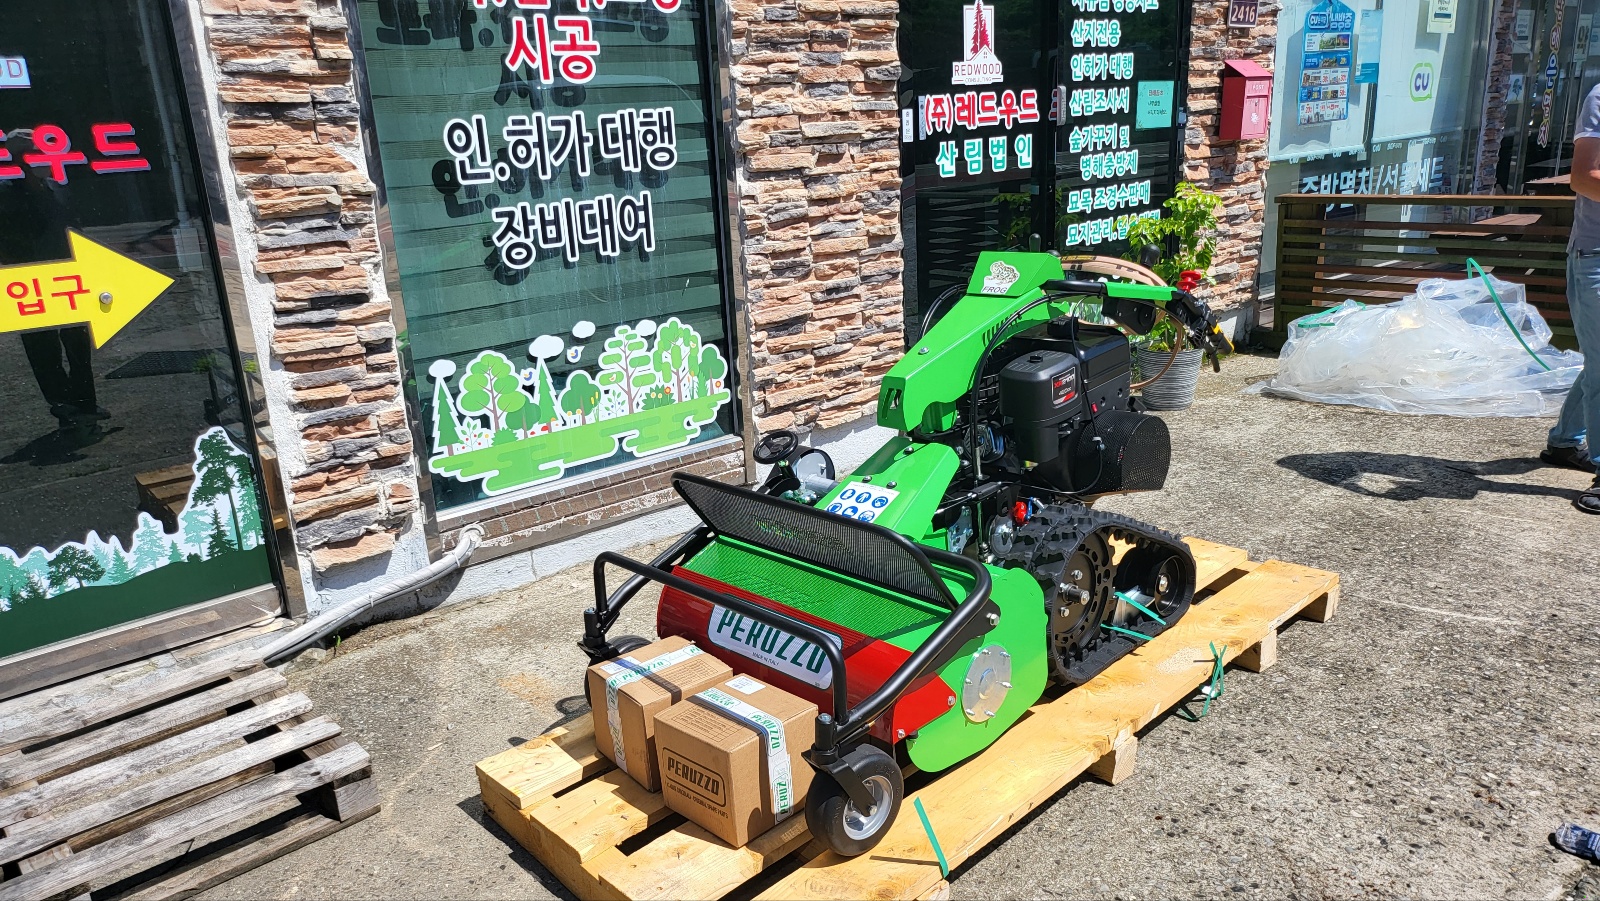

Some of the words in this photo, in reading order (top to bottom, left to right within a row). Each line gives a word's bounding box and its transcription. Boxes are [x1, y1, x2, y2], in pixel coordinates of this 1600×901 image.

[1231, 5, 1256, 22] 2416
[1071, 19, 1121, 47] 산지전용
[505, 14, 600, 84] 시공
[0, 60, 22, 78] D
[954, 63, 1001, 76] REDWOOD
[1071, 53, 1108, 81] 인허가
[1109, 53, 1134, 80] 대행
[1414, 73, 1430, 91] CU
[925, 89, 1039, 135] (주)레드우드
[1070, 87, 1129, 116] 산림조사서
[443, 110, 593, 184] 인.허가
[599, 107, 677, 171] 대행
[1069, 123, 1117, 153] 숲가꾸기
[1119, 126, 1130, 148] 및
[1080, 149, 1138, 181] 병해충방제
[1067, 188, 1092, 213] 묘목
[1094, 180, 1151, 210] 조경수판매
[492, 191, 655, 269] 장비대여
[6, 275, 90, 316] 입구
[982, 286, 1008, 294] FROG
[716, 608, 828, 674] PERUZZO
[622, 660, 665, 681] PERUZZO
[750, 714, 781, 750] PERUZZO
[667, 756, 720, 796] PERUZZO
